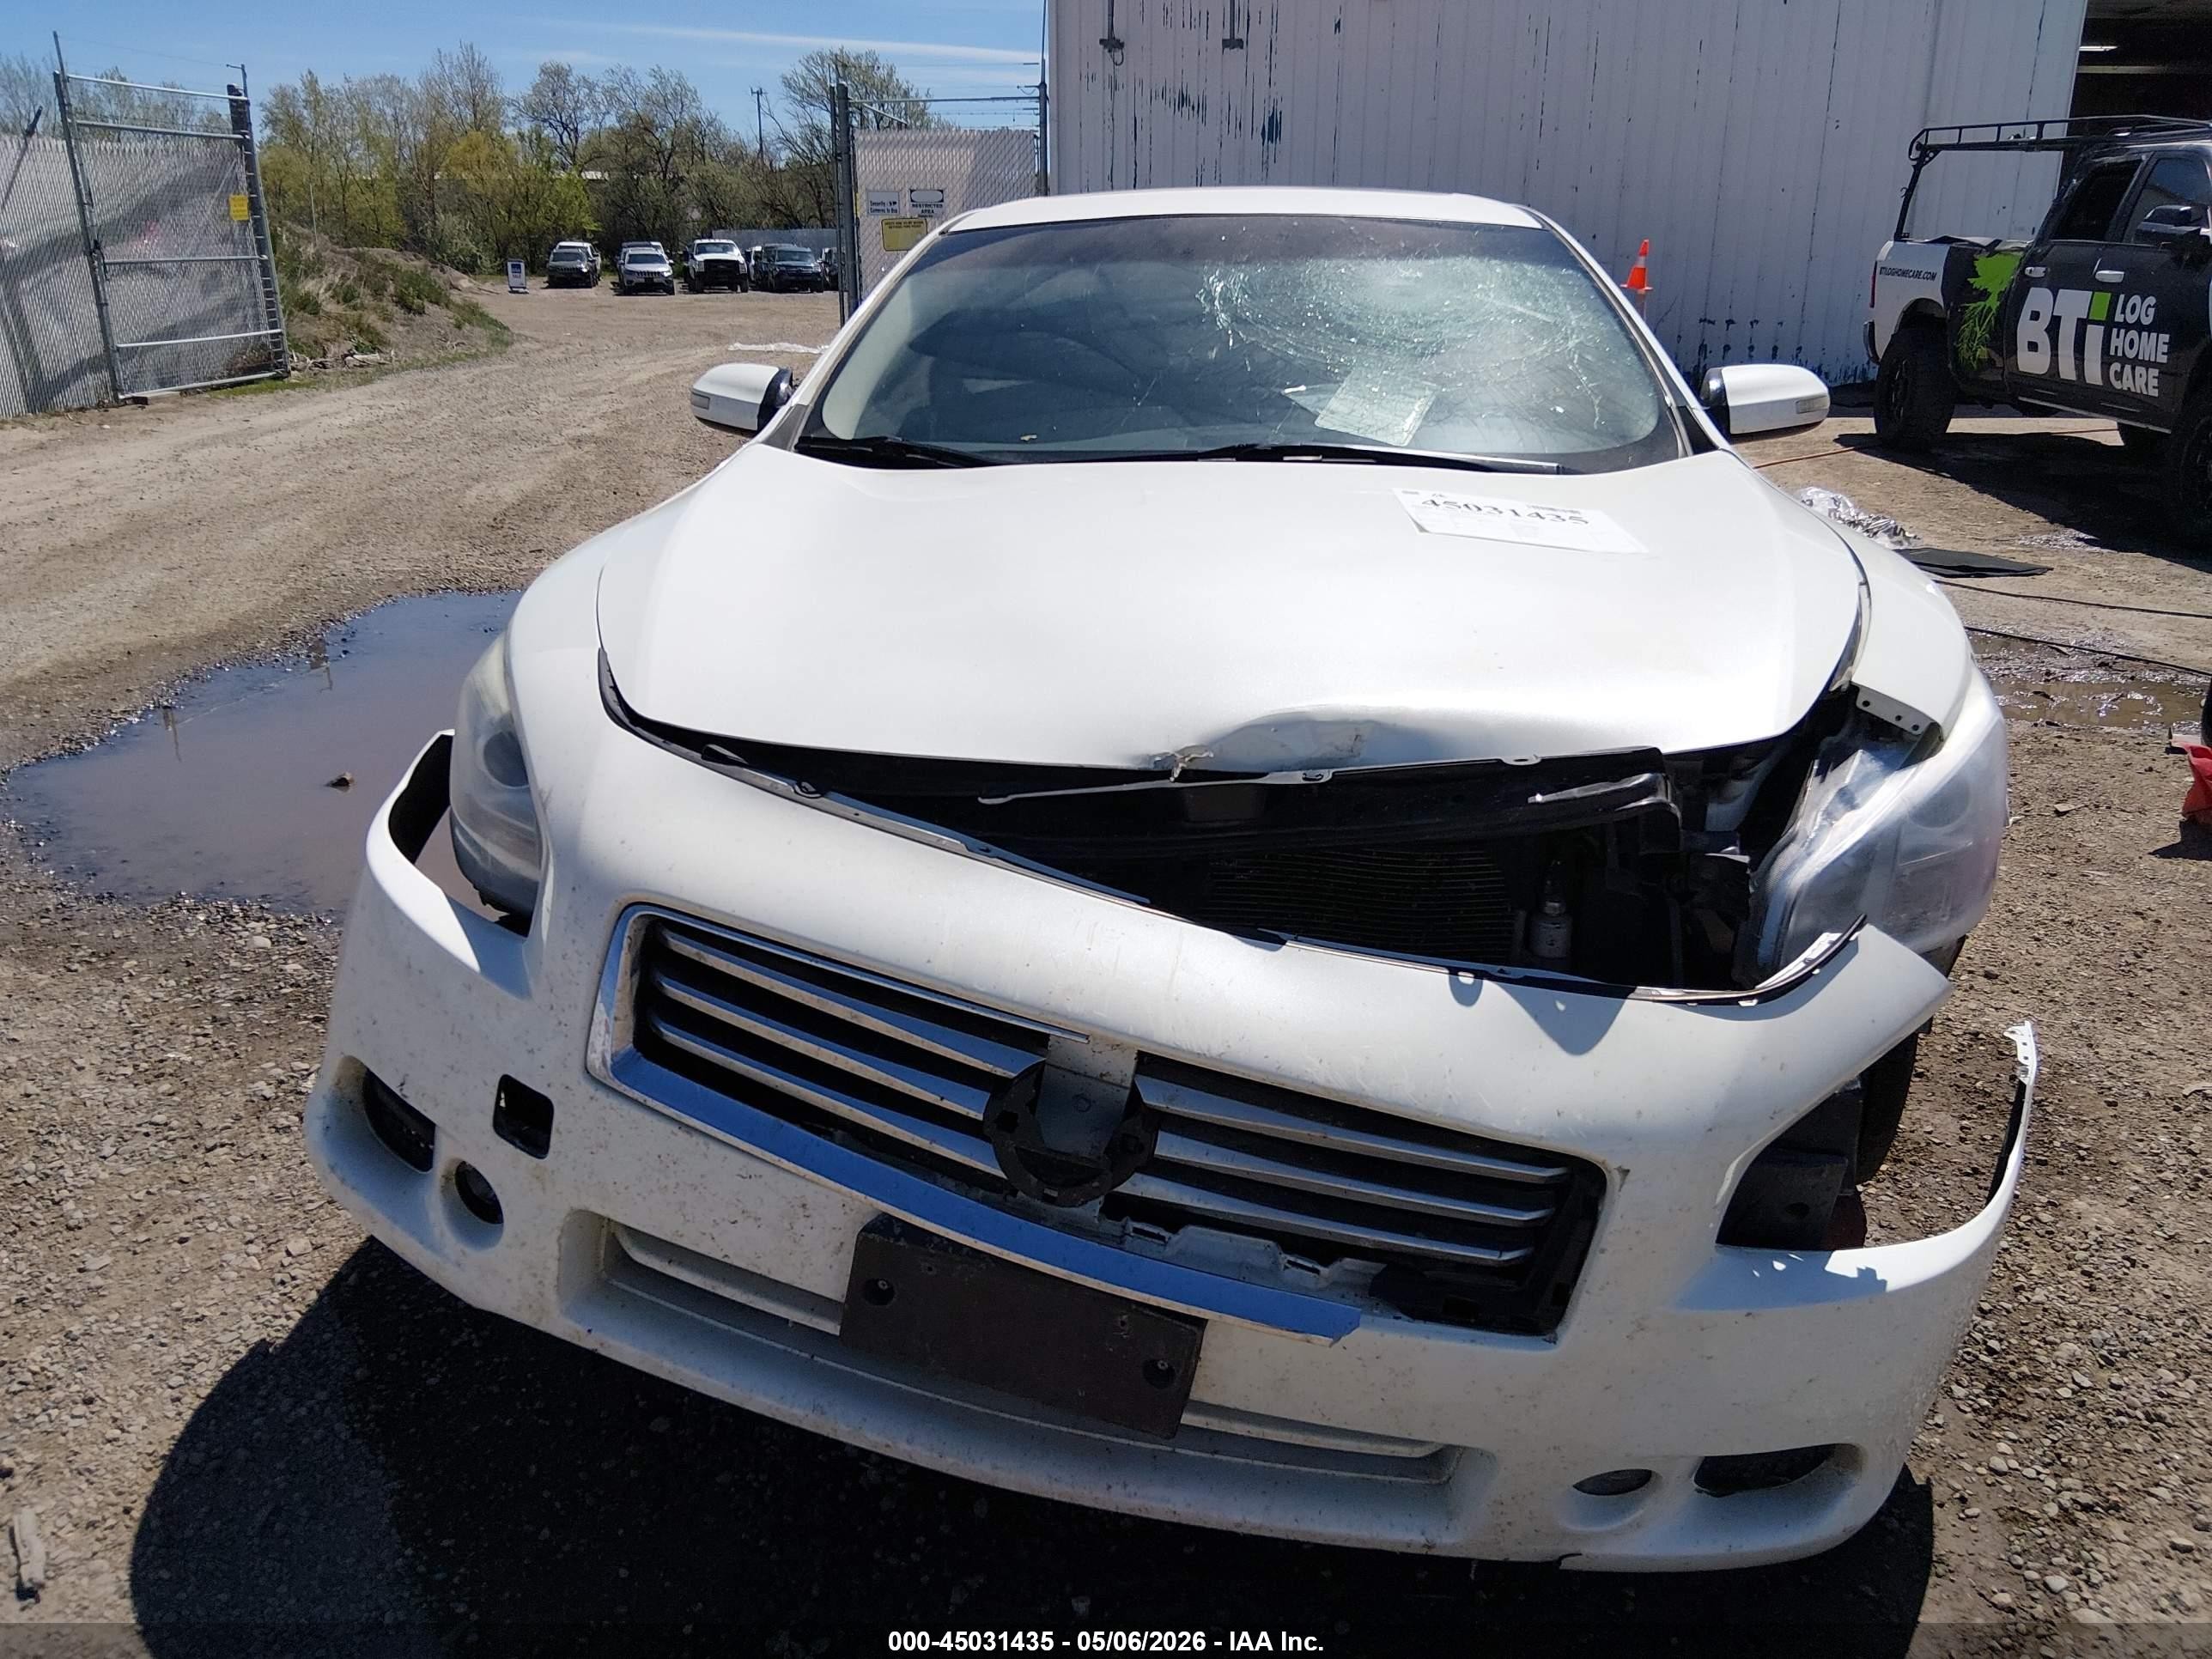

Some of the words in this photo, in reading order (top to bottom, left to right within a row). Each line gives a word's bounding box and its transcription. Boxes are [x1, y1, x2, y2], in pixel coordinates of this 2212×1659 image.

[2114, 294, 2156, 325] LOG
[2109, 328, 2170, 363] HOME
[2109, 362, 2159, 397] CARE
[1422, 499, 1589, 524] 45031435
